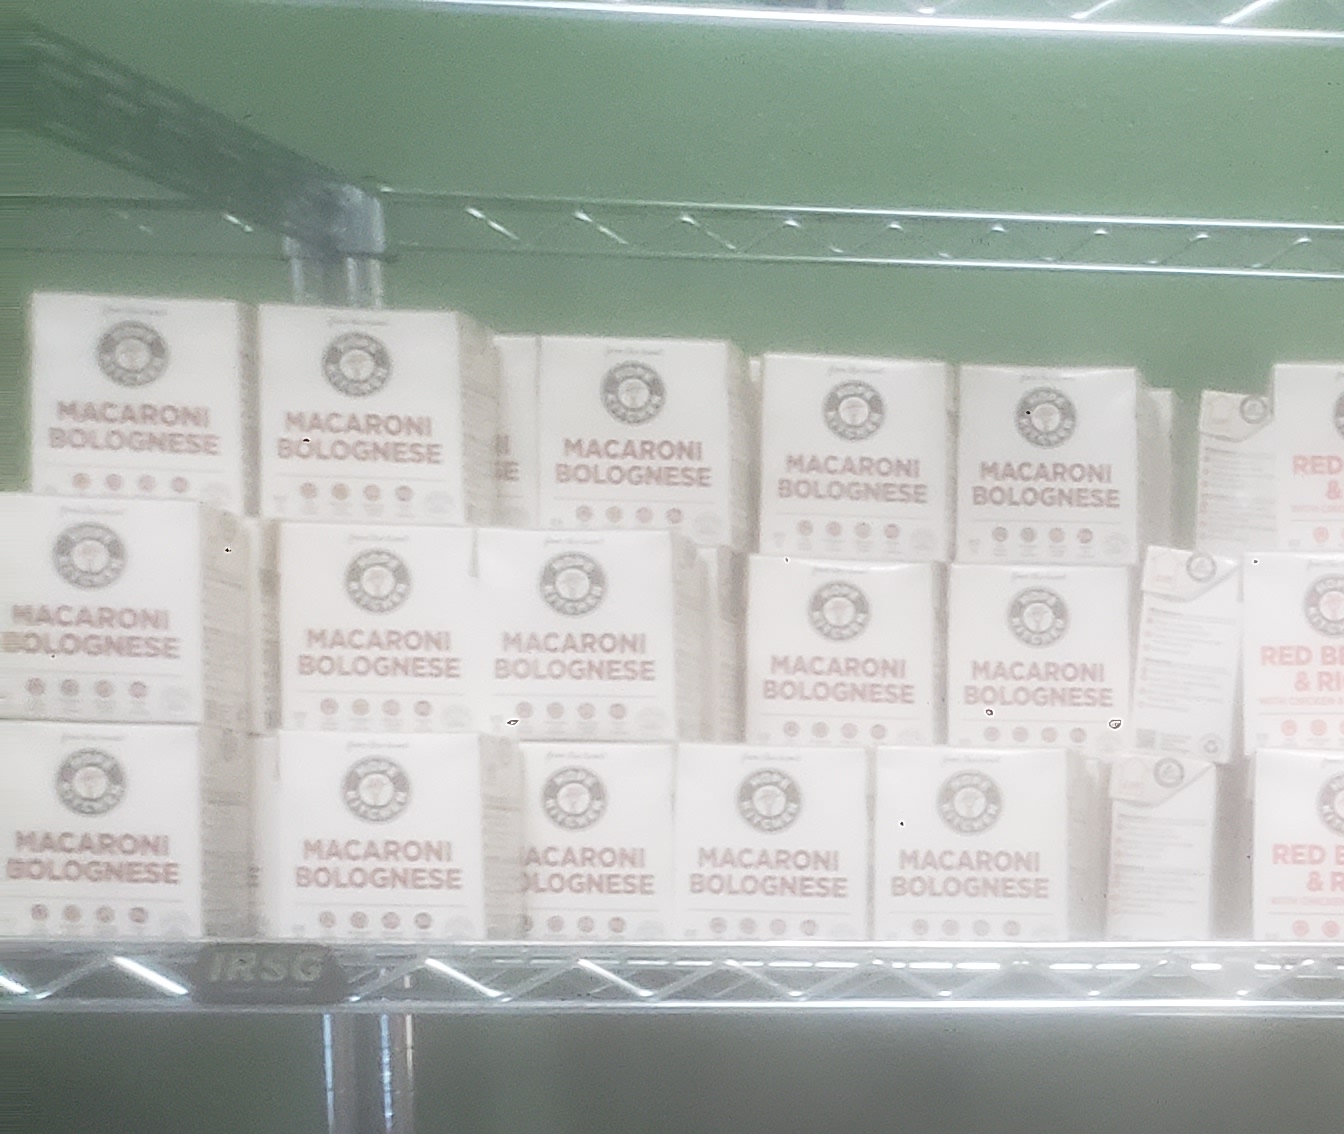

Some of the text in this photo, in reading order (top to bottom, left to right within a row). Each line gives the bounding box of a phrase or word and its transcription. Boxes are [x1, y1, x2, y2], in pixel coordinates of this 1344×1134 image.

[57, 401, 210, 428] MACARONI
[286, 411, 432, 437] MACARONI
[48, 428, 220, 455] BOLOGNESE
[277, 437, 443, 465] BOLOGNESE
[563, 437, 703, 462] MACARONI
[555, 463, 712, 488] BOLOGNESE
[786, 454, 920, 478] MACARONI
[979, 462, 1112, 483] MACARONI
[1292, 454, 1344, 475] RED
[778, 480, 928, 503] BOLOGNESE
[972, 486, 1120, 508] BOLOGNESE
[306, 629, 451, 651] MACARONI
[502, 632, 646, 654] MACARONI
[299, 655, 460, 678] BOLOGNESE
[770, 655, 906, 678] MACARONI
[1260, 645, 1312, 666] RED
[495, 658, 656, 681] BOLOGNESE
[972, 661, 1104, 683] MACARONI
[763, 680, 914, 704] BOLOGNESE
[964, 686, 1113, 707] BOLOGNESE
[15, 831, 169, 856] MACARONI
[303, 840, 453, 862] MACARONI
[1272, 843, 1326, 865] RED
[698, 847, 840, 871] MACARONI
[900, 849, 1040, 871] MACARONI
[7, 858, 180, 884] BOLOGNESE
[296, 867, 463, 890] BOLOGNESE
[689, 875, 848, 897] BOLOGNESE
[891, 876, 1049, 899] BOLOGNESE
